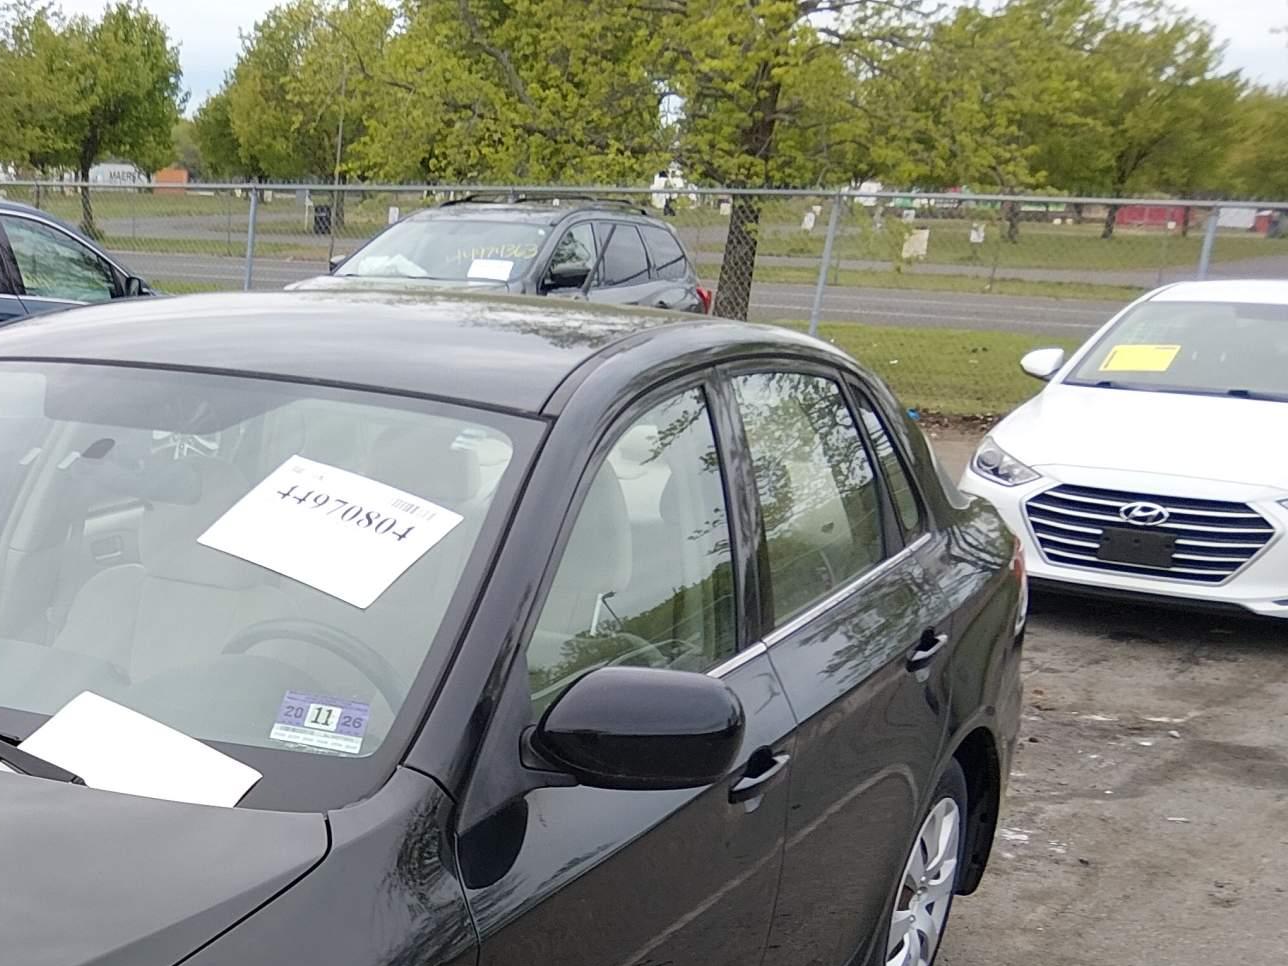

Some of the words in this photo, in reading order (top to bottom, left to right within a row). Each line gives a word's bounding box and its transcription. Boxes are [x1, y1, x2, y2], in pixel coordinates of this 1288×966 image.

[276, 484, 416, 542] 44970804
[283, 705, 305, 719] 20
[310, 706, 333, 727] 11
[340, 715, 363, 729] 26
